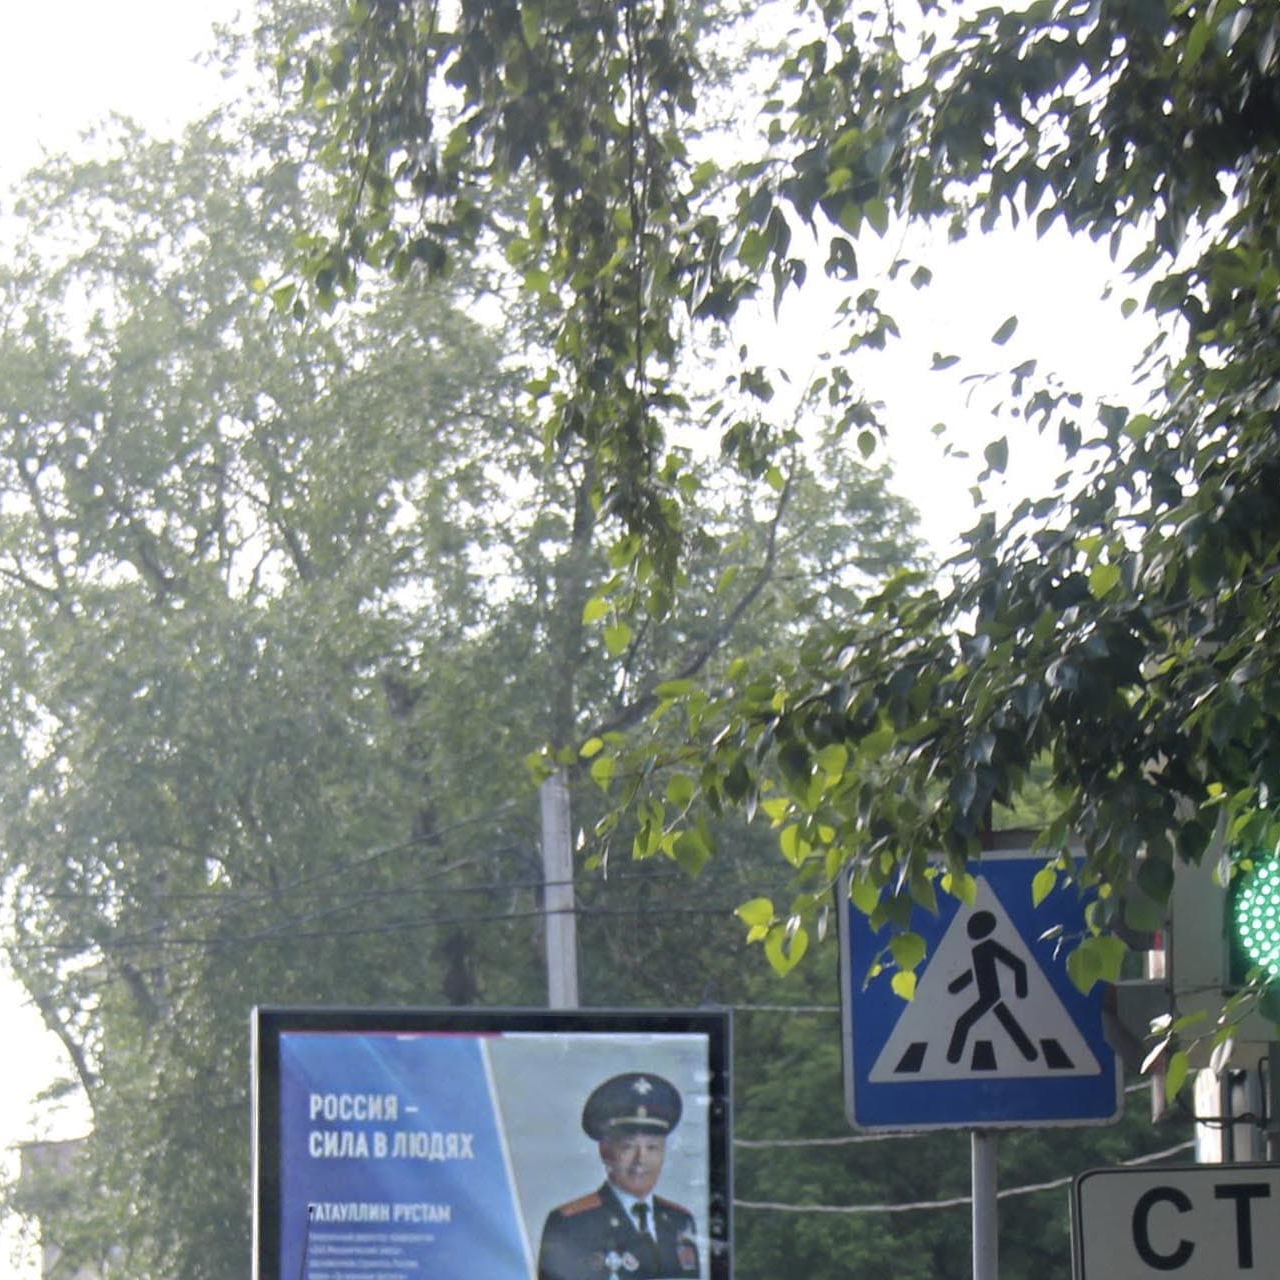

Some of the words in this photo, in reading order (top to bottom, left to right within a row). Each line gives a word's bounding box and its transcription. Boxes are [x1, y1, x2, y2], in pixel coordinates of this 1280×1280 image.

[309, 1093, 398, 1121] РОССИЯ
[309, 1131, 369, 1158] СИЛА
[373, 1131, 387, 1158] В
[392, 1131, 474, 1161] ЛЮДЯХ
[394, 1203, 452, 1223] РУСТАМ
